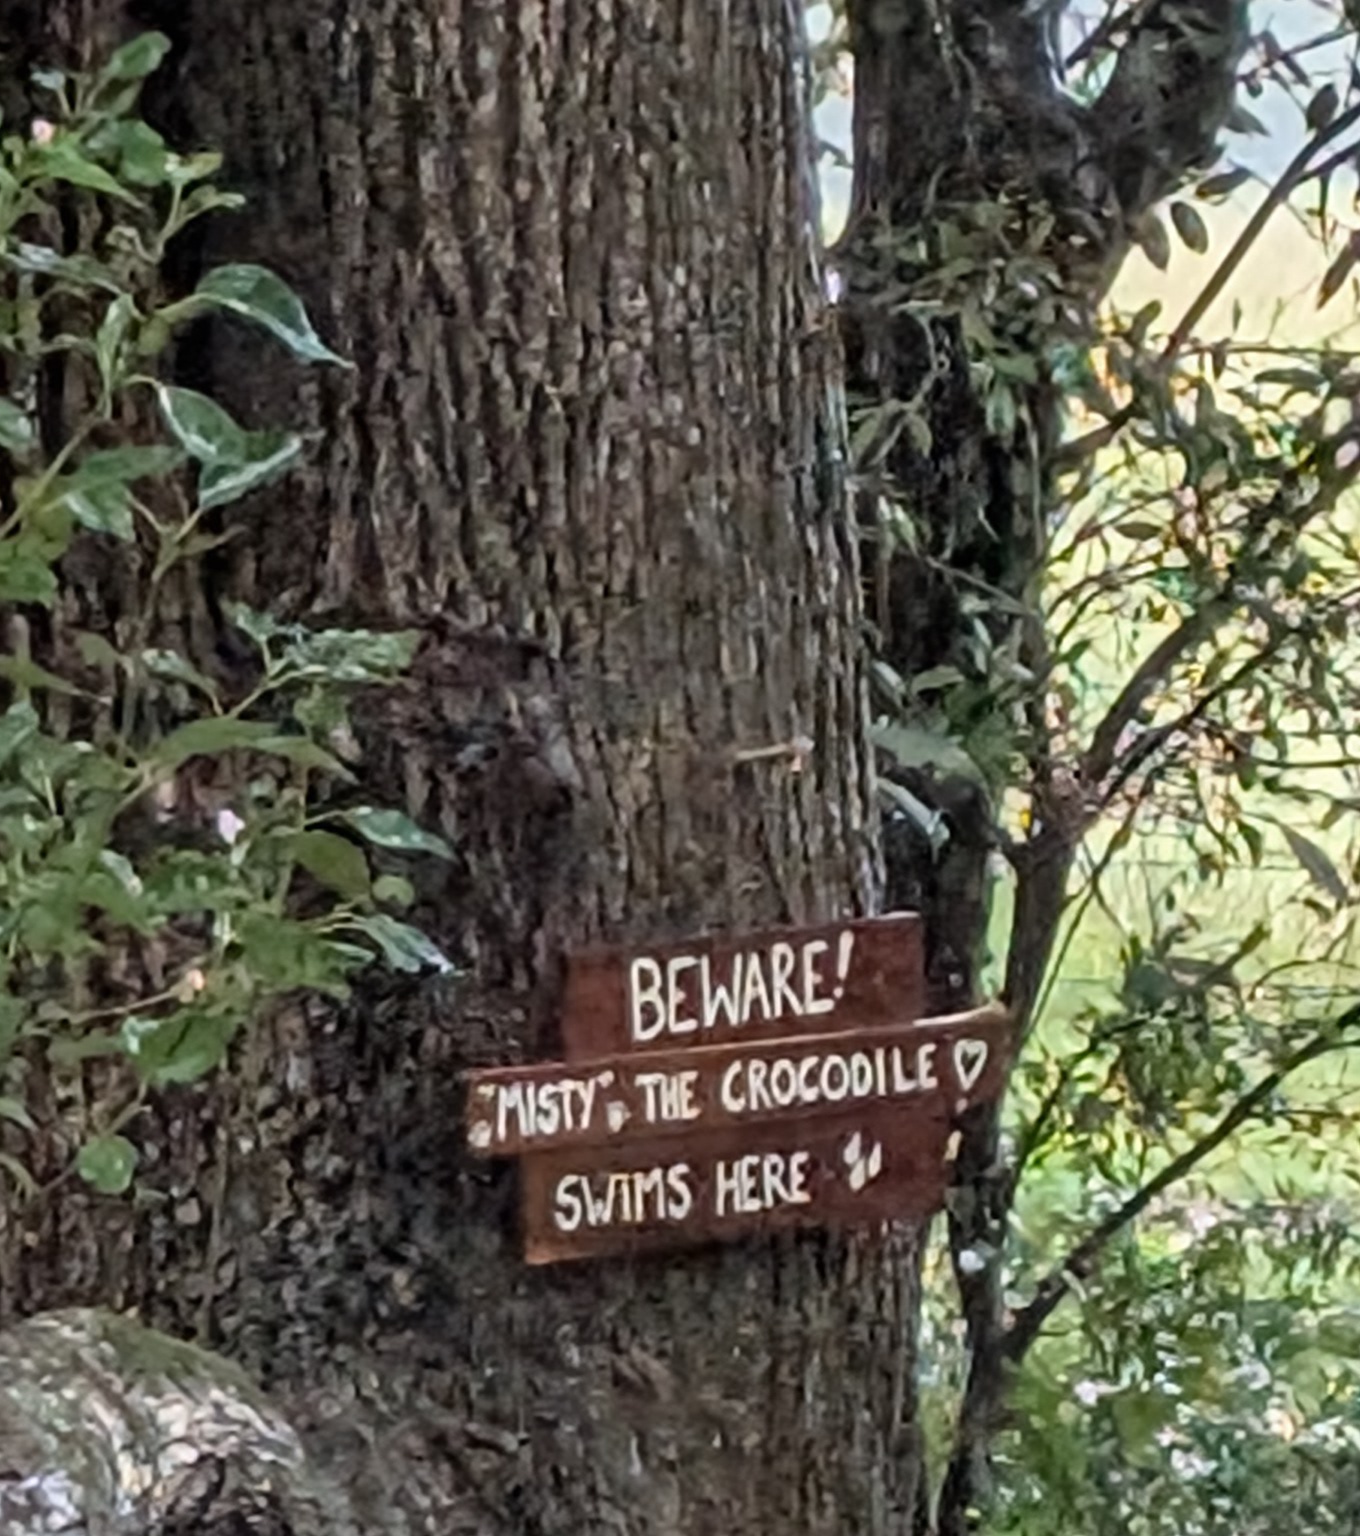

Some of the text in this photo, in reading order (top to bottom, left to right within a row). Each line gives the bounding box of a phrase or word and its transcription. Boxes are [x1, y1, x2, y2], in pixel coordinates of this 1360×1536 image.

[630, 931, 854, 1041] BEWARE!
[634, 1070, 702, 1124] THE
[721, 1043, 939, 1112] CROCODILE
[554, 1151, 811, 1231] SWIMS HERE
